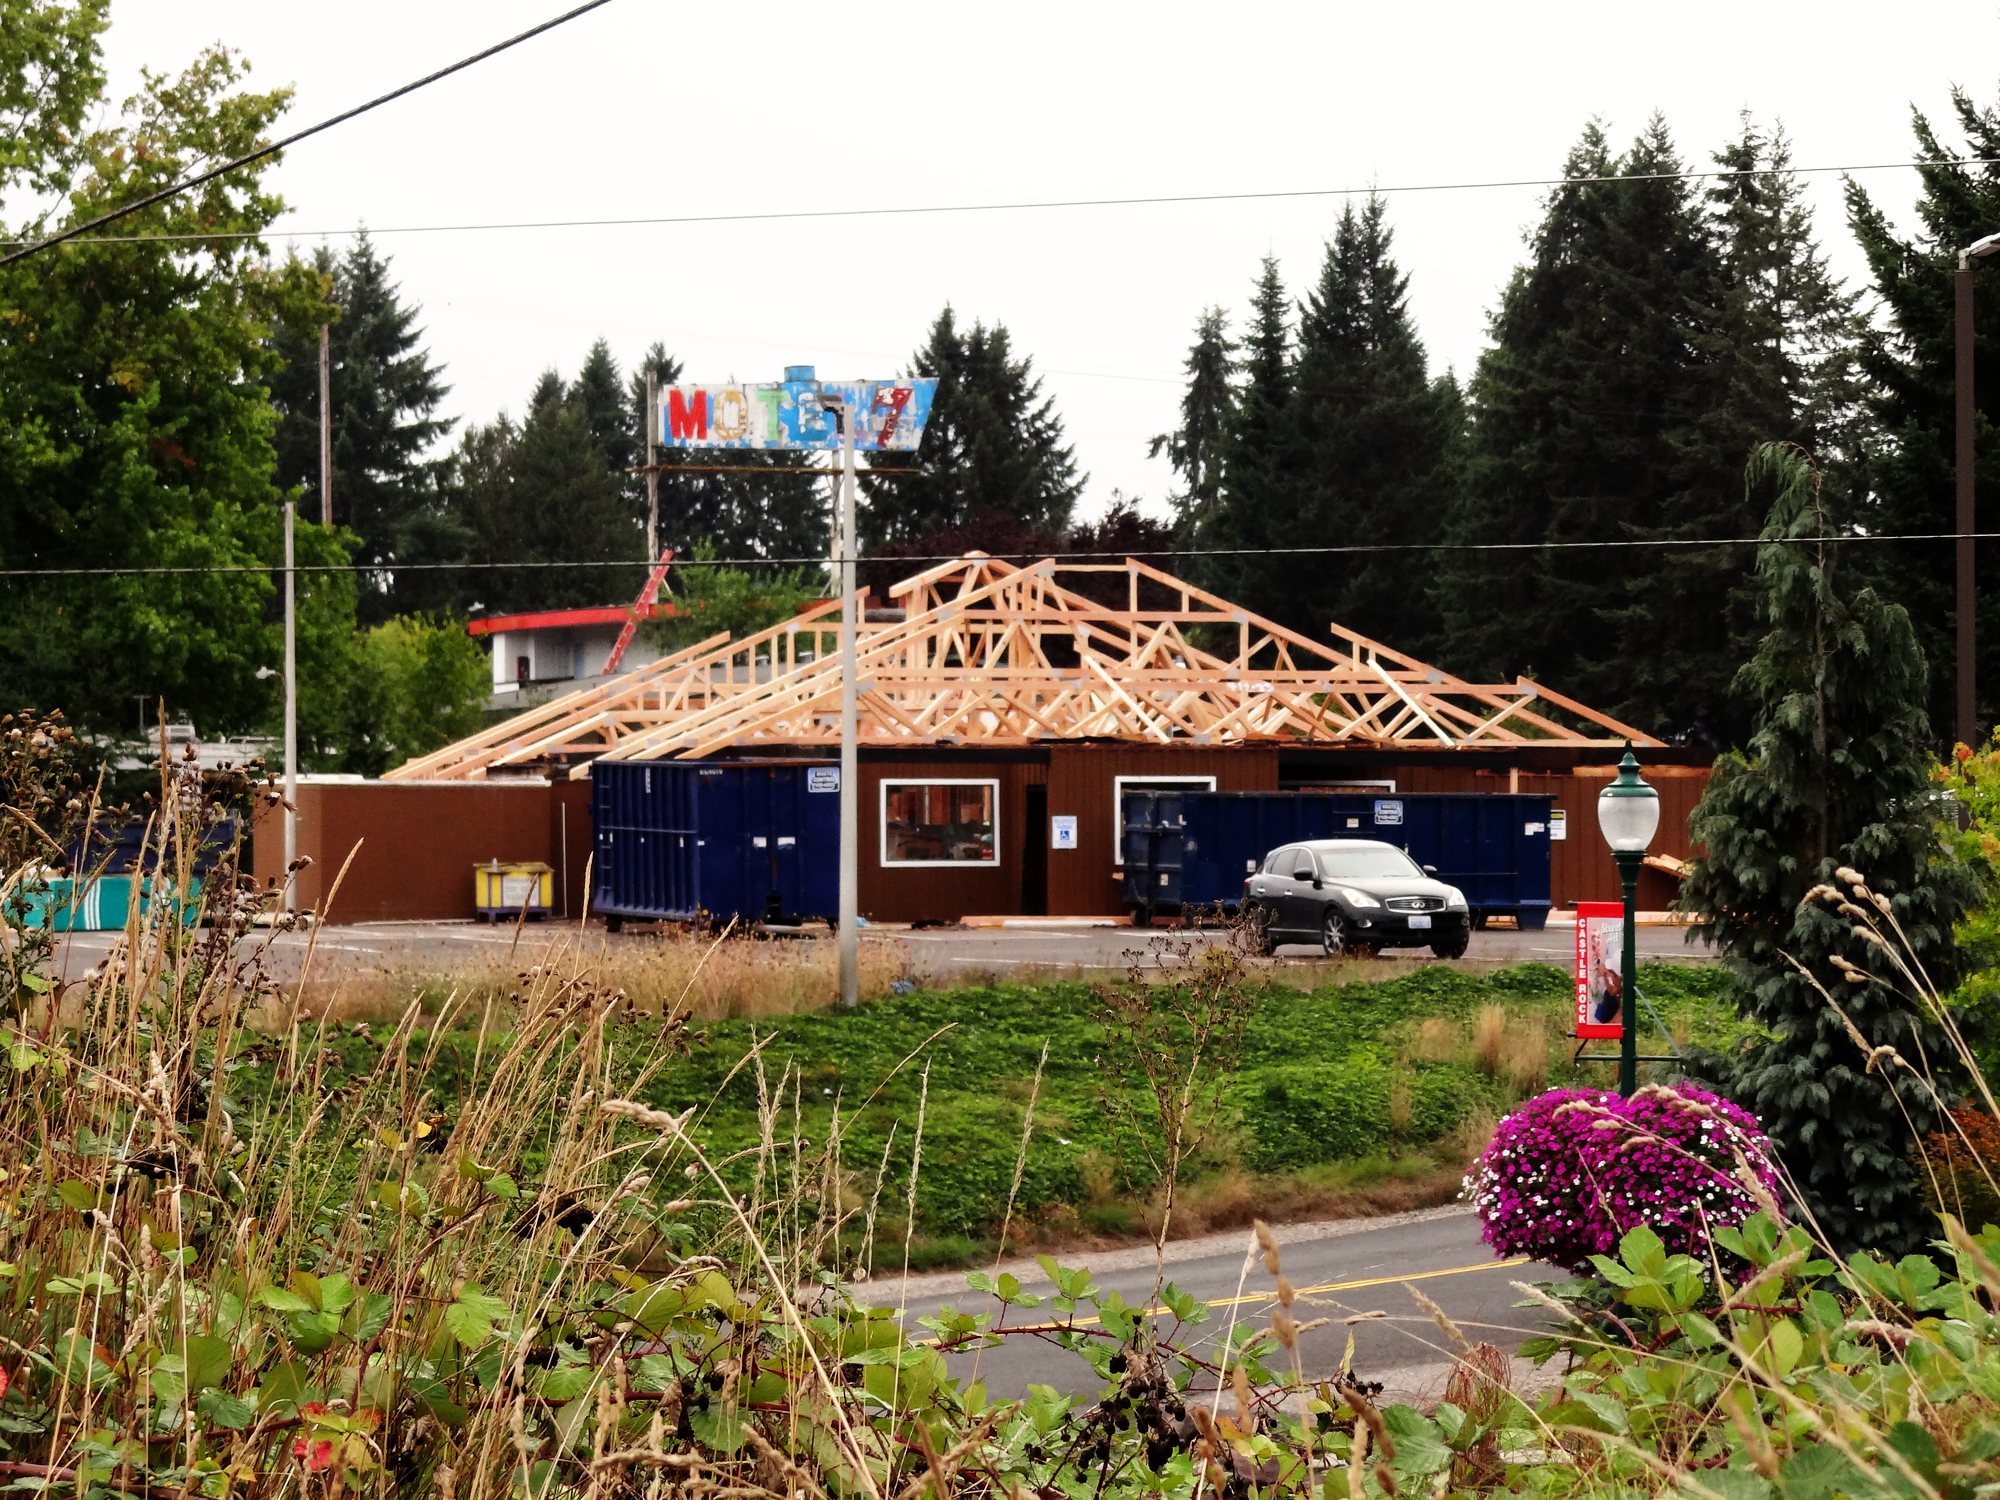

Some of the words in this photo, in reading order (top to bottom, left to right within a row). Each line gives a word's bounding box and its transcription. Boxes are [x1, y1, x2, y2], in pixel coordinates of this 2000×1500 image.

[669, 388, 868, 441] MOTE
[871, 386, 914, 448] 7
[1578, 918, 1587, 979] CASTLE
[1578, 983, 1587, 1024] ROCK
